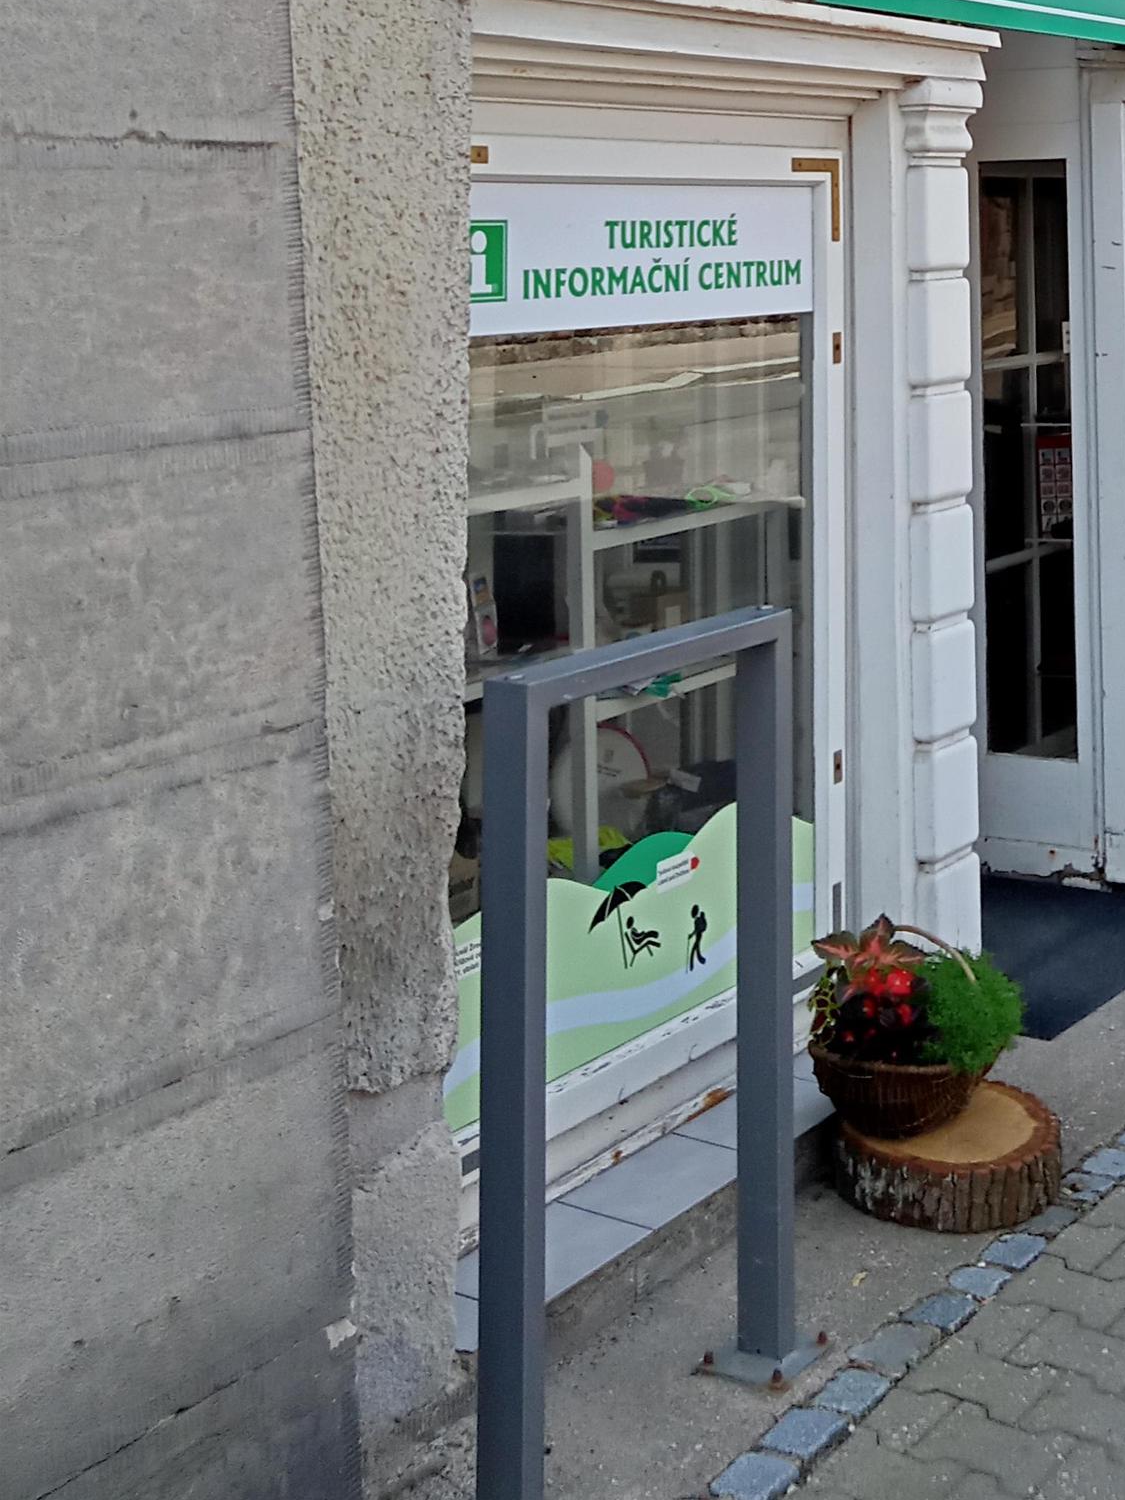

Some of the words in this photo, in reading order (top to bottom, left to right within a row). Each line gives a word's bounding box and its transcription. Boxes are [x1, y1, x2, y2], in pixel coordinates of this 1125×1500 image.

[604, 212, 739, 250] TURISTICKÉ
[522, 256, 691, 300] INFORMAČNÍ
[698, 258, 802, 291] CENTRUM
